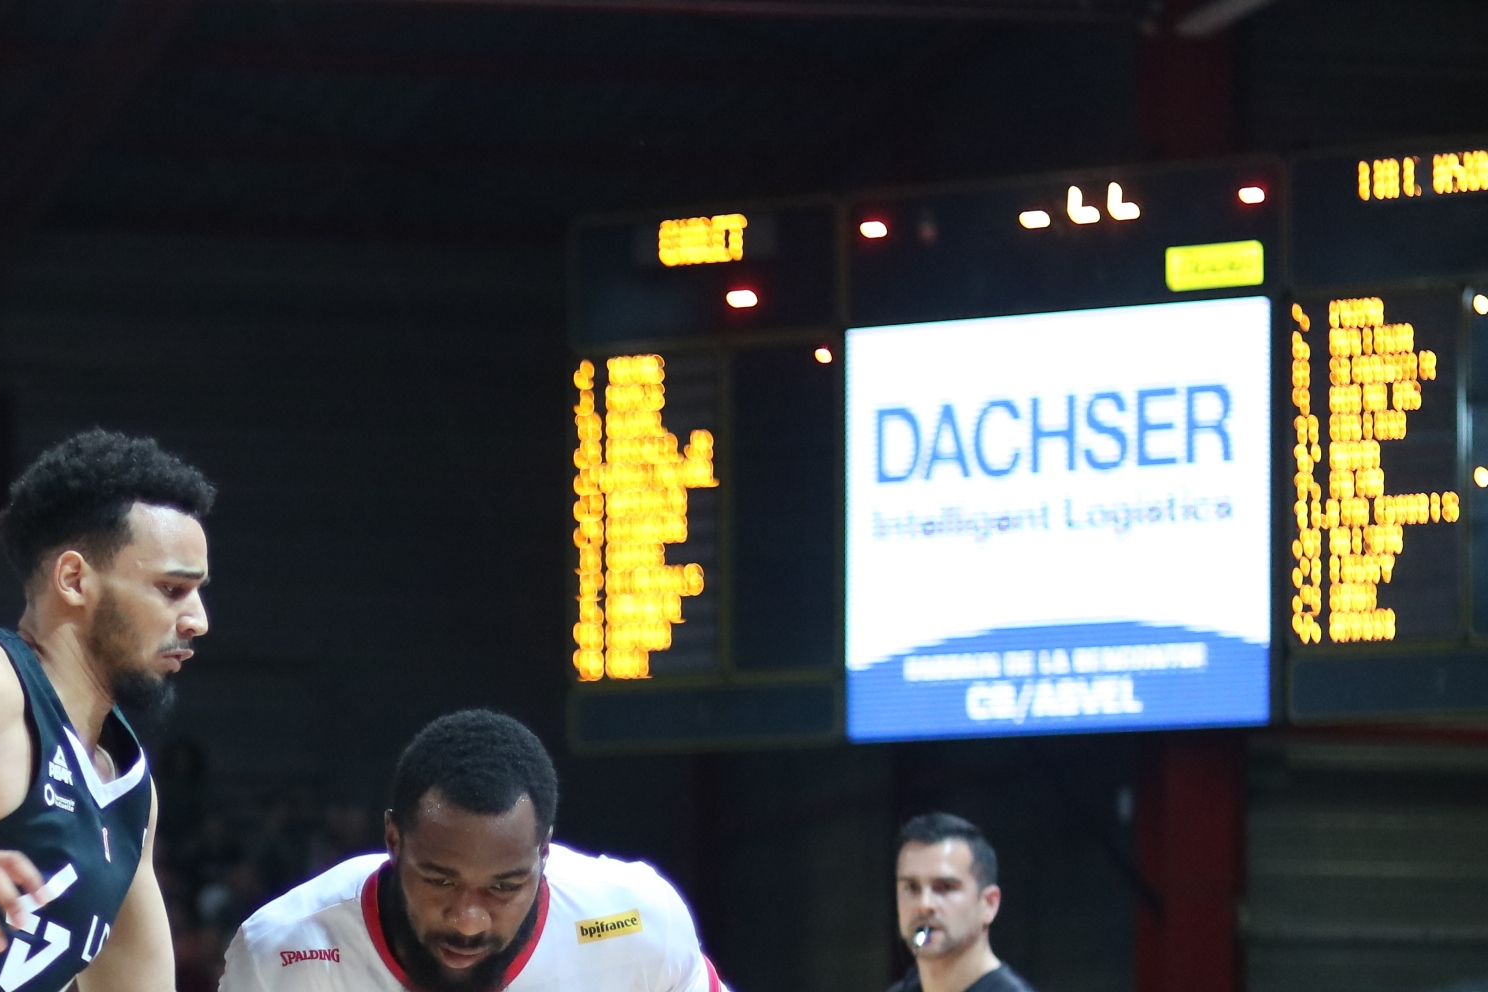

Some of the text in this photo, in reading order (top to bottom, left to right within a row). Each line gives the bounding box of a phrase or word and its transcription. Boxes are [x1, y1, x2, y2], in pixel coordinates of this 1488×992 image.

[876, 383, 1234, 484] DACHSER
[48, 761, 74, 786] PEAK
[579, 915, 639, 939] bpifrance
[279, 947, 341, 967] SPALDING
